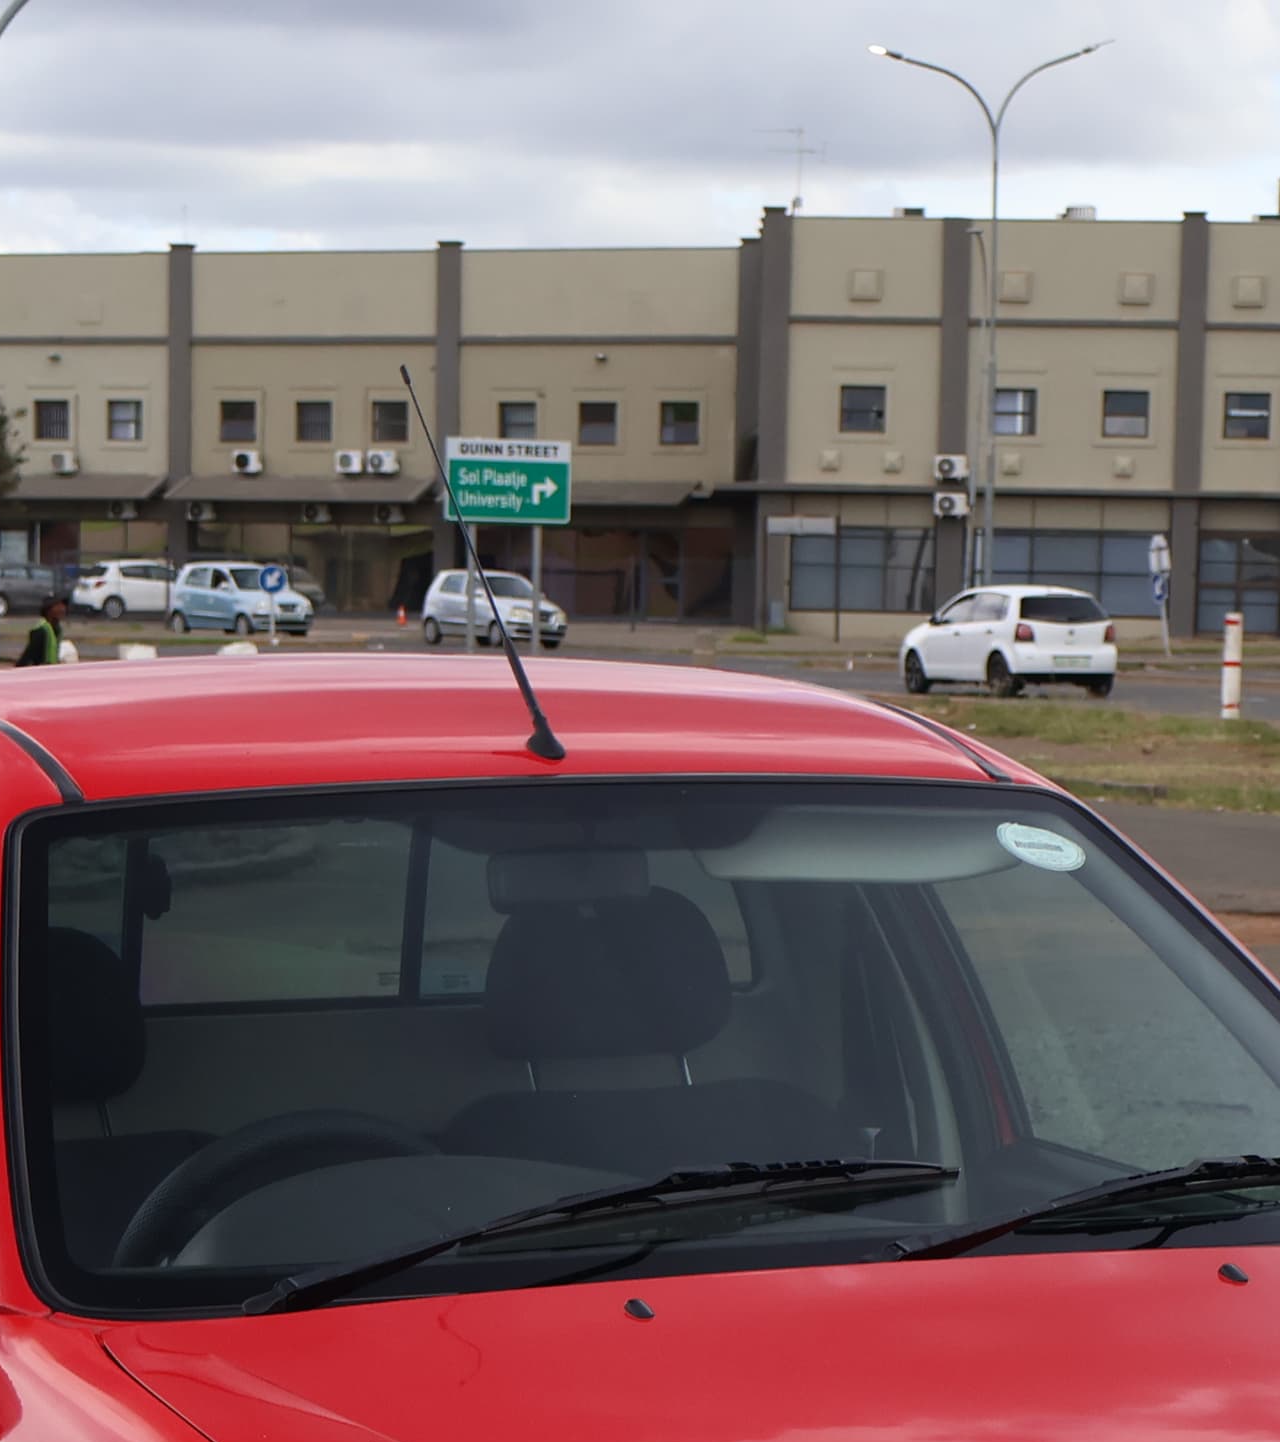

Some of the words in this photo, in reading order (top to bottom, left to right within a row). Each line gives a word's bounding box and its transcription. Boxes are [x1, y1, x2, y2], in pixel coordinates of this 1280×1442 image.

[507, 444, 559, 458] STREET
[458, 467, 480, 486] Sol
[482, 468, 528, 491] Plaatje
[459, 491, 523, 512] University
